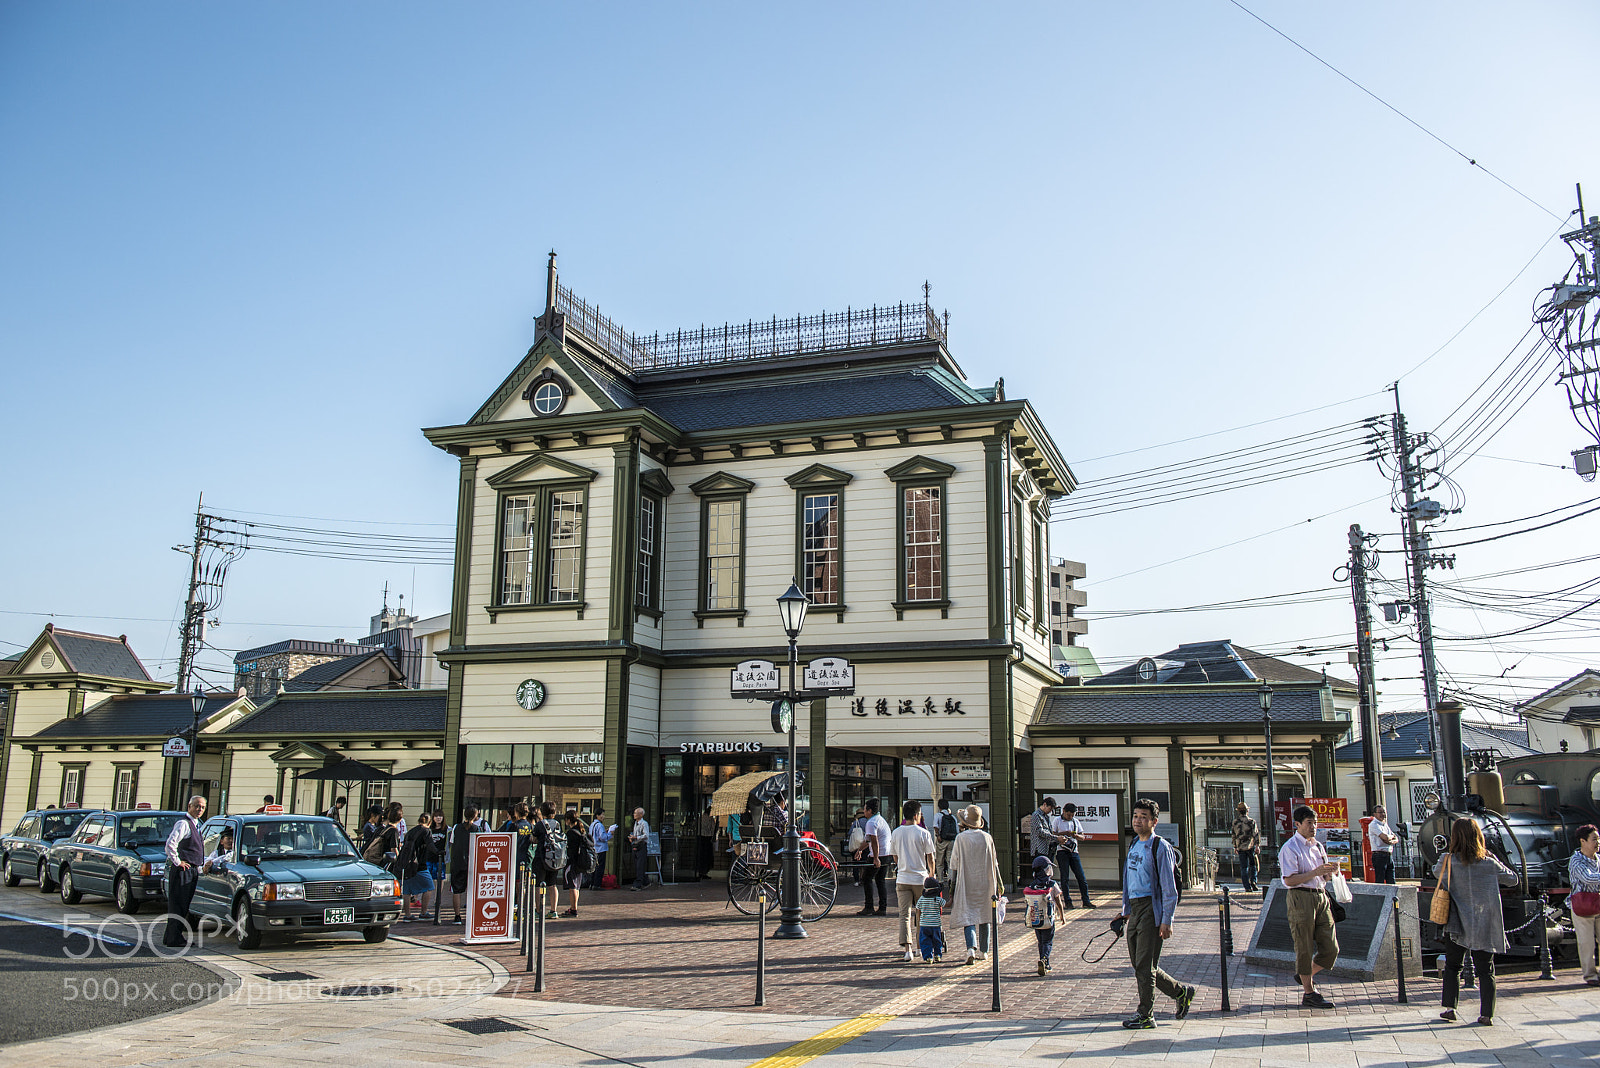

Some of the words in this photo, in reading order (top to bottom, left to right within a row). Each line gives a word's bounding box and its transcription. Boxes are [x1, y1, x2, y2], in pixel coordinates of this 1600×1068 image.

[736, 671, 776, 682] 道後公園
[808, 668, 850, 681] 道後温泉
[852, 696, 966, 717] 道後温泉駅
[680, 742, 762, 752] STARBUCKS
[1051, 806, 1110, 817] 道温泉駅
[1318, 804, 1345, 817] Day
[480, 875, 504, 883] 伊予鉄
[480, 883, 504, 891] タクシー
